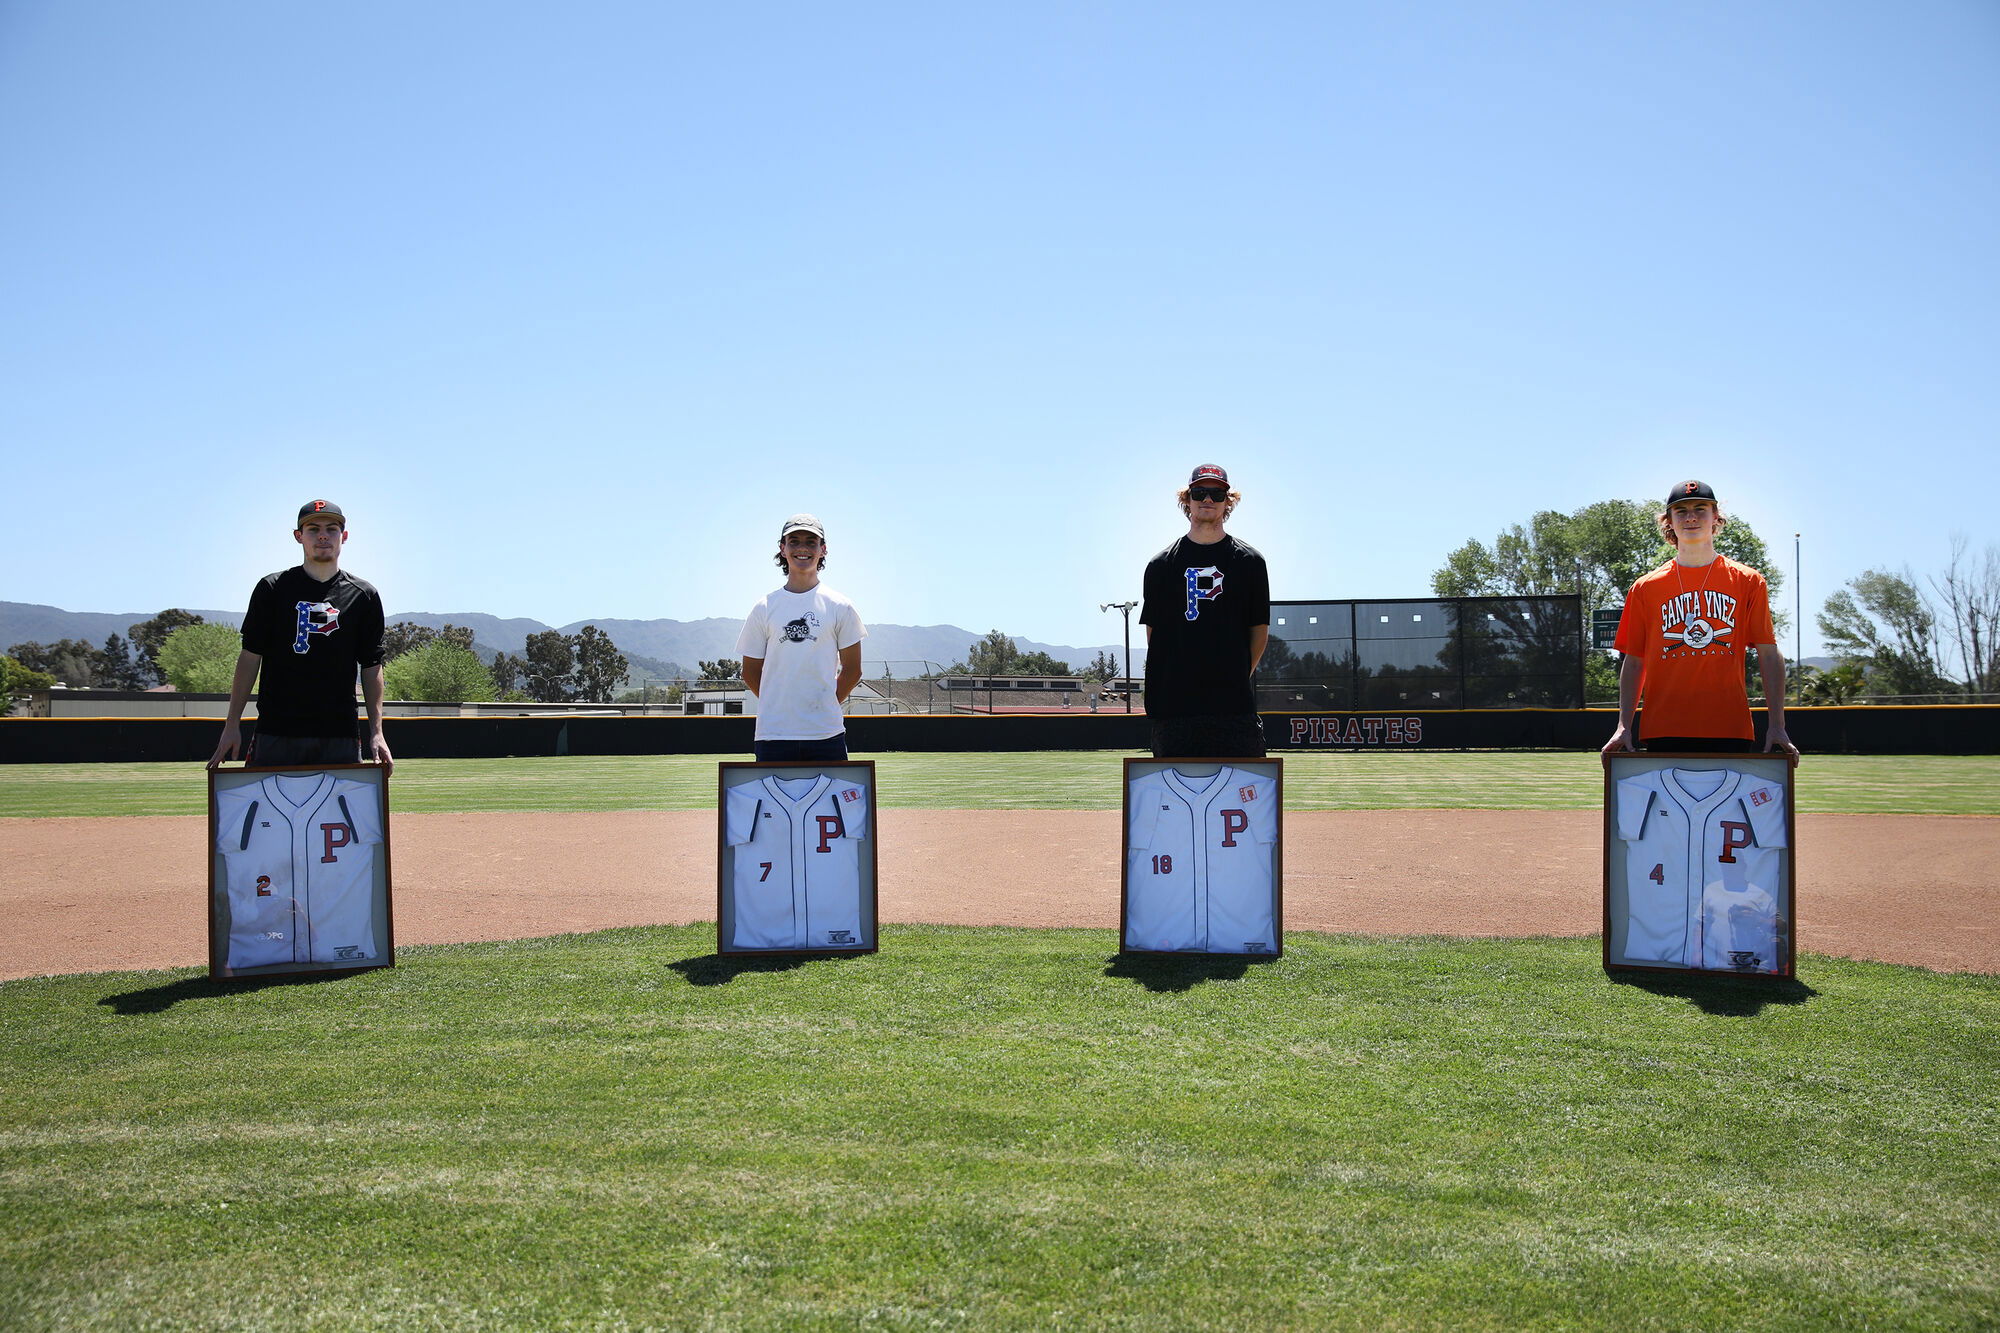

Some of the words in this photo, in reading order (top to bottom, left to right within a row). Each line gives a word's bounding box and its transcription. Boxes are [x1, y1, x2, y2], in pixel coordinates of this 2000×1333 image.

[1685, 481, 1699, 494] P
[314, 501, 326, 512] P
[1184, 565, 1225, 621] P
[1661, 589, 1701, 632] SANTA
[1703, 590, 1737, 628] YNEZ
[293, 601, 340, 654] P
[1661, 649, 1735, 659] BASEBALL
[1290, 718, 1422, 743] PIRATES
[815, 816, 846, 853] P
[1220, 809, 1249, 847] P
[320, 822, 351, 863] P
[1718, 820, 1752, 864] P
[759, 862, 772, 882] 7
[1151, 854, 1173, 875] 18
[1649, 863, 1665, 886] 4
[256, 875, 272, 897] 2
